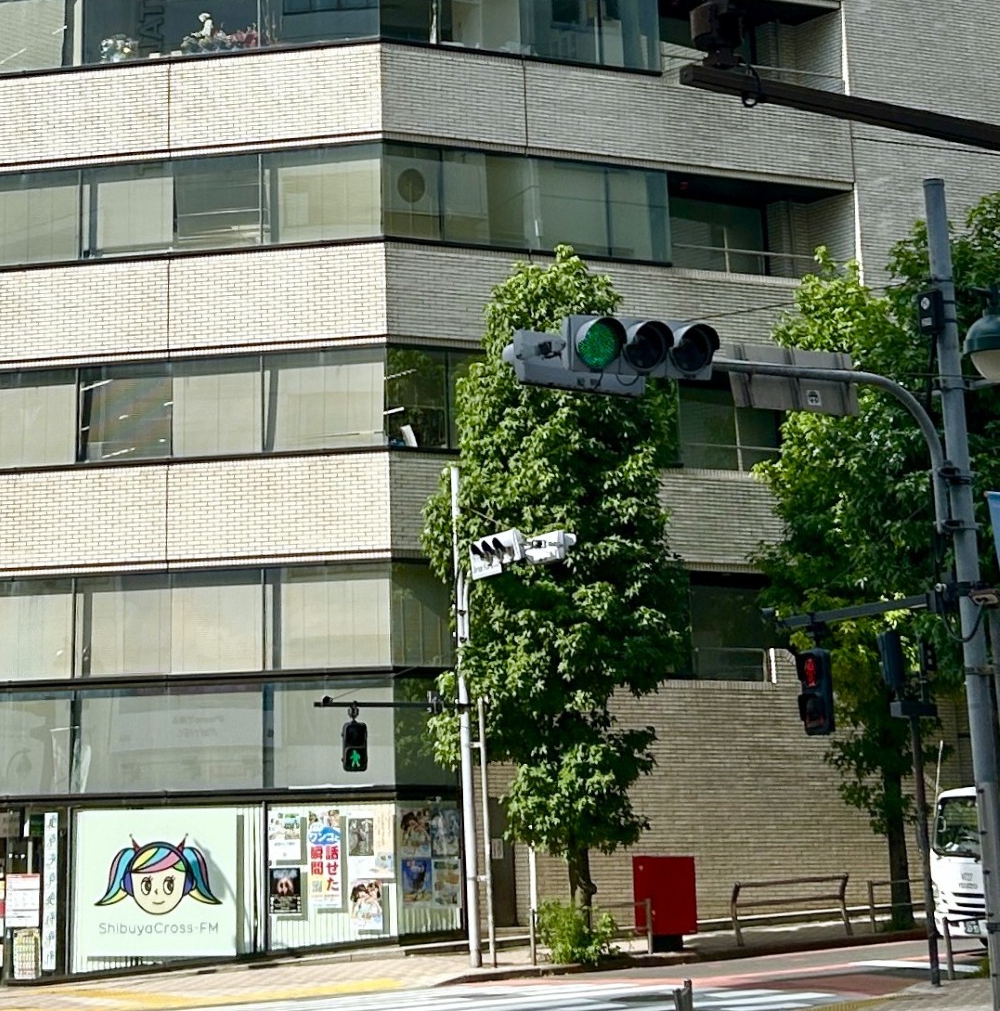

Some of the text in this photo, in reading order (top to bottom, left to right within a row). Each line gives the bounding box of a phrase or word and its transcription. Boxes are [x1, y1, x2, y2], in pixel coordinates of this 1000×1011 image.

[310, 846, 324, 876] 瞬間
[325, 845, 339, 892] 話せた
[98, 921, 220, 937] ShibuyaCross-FM
